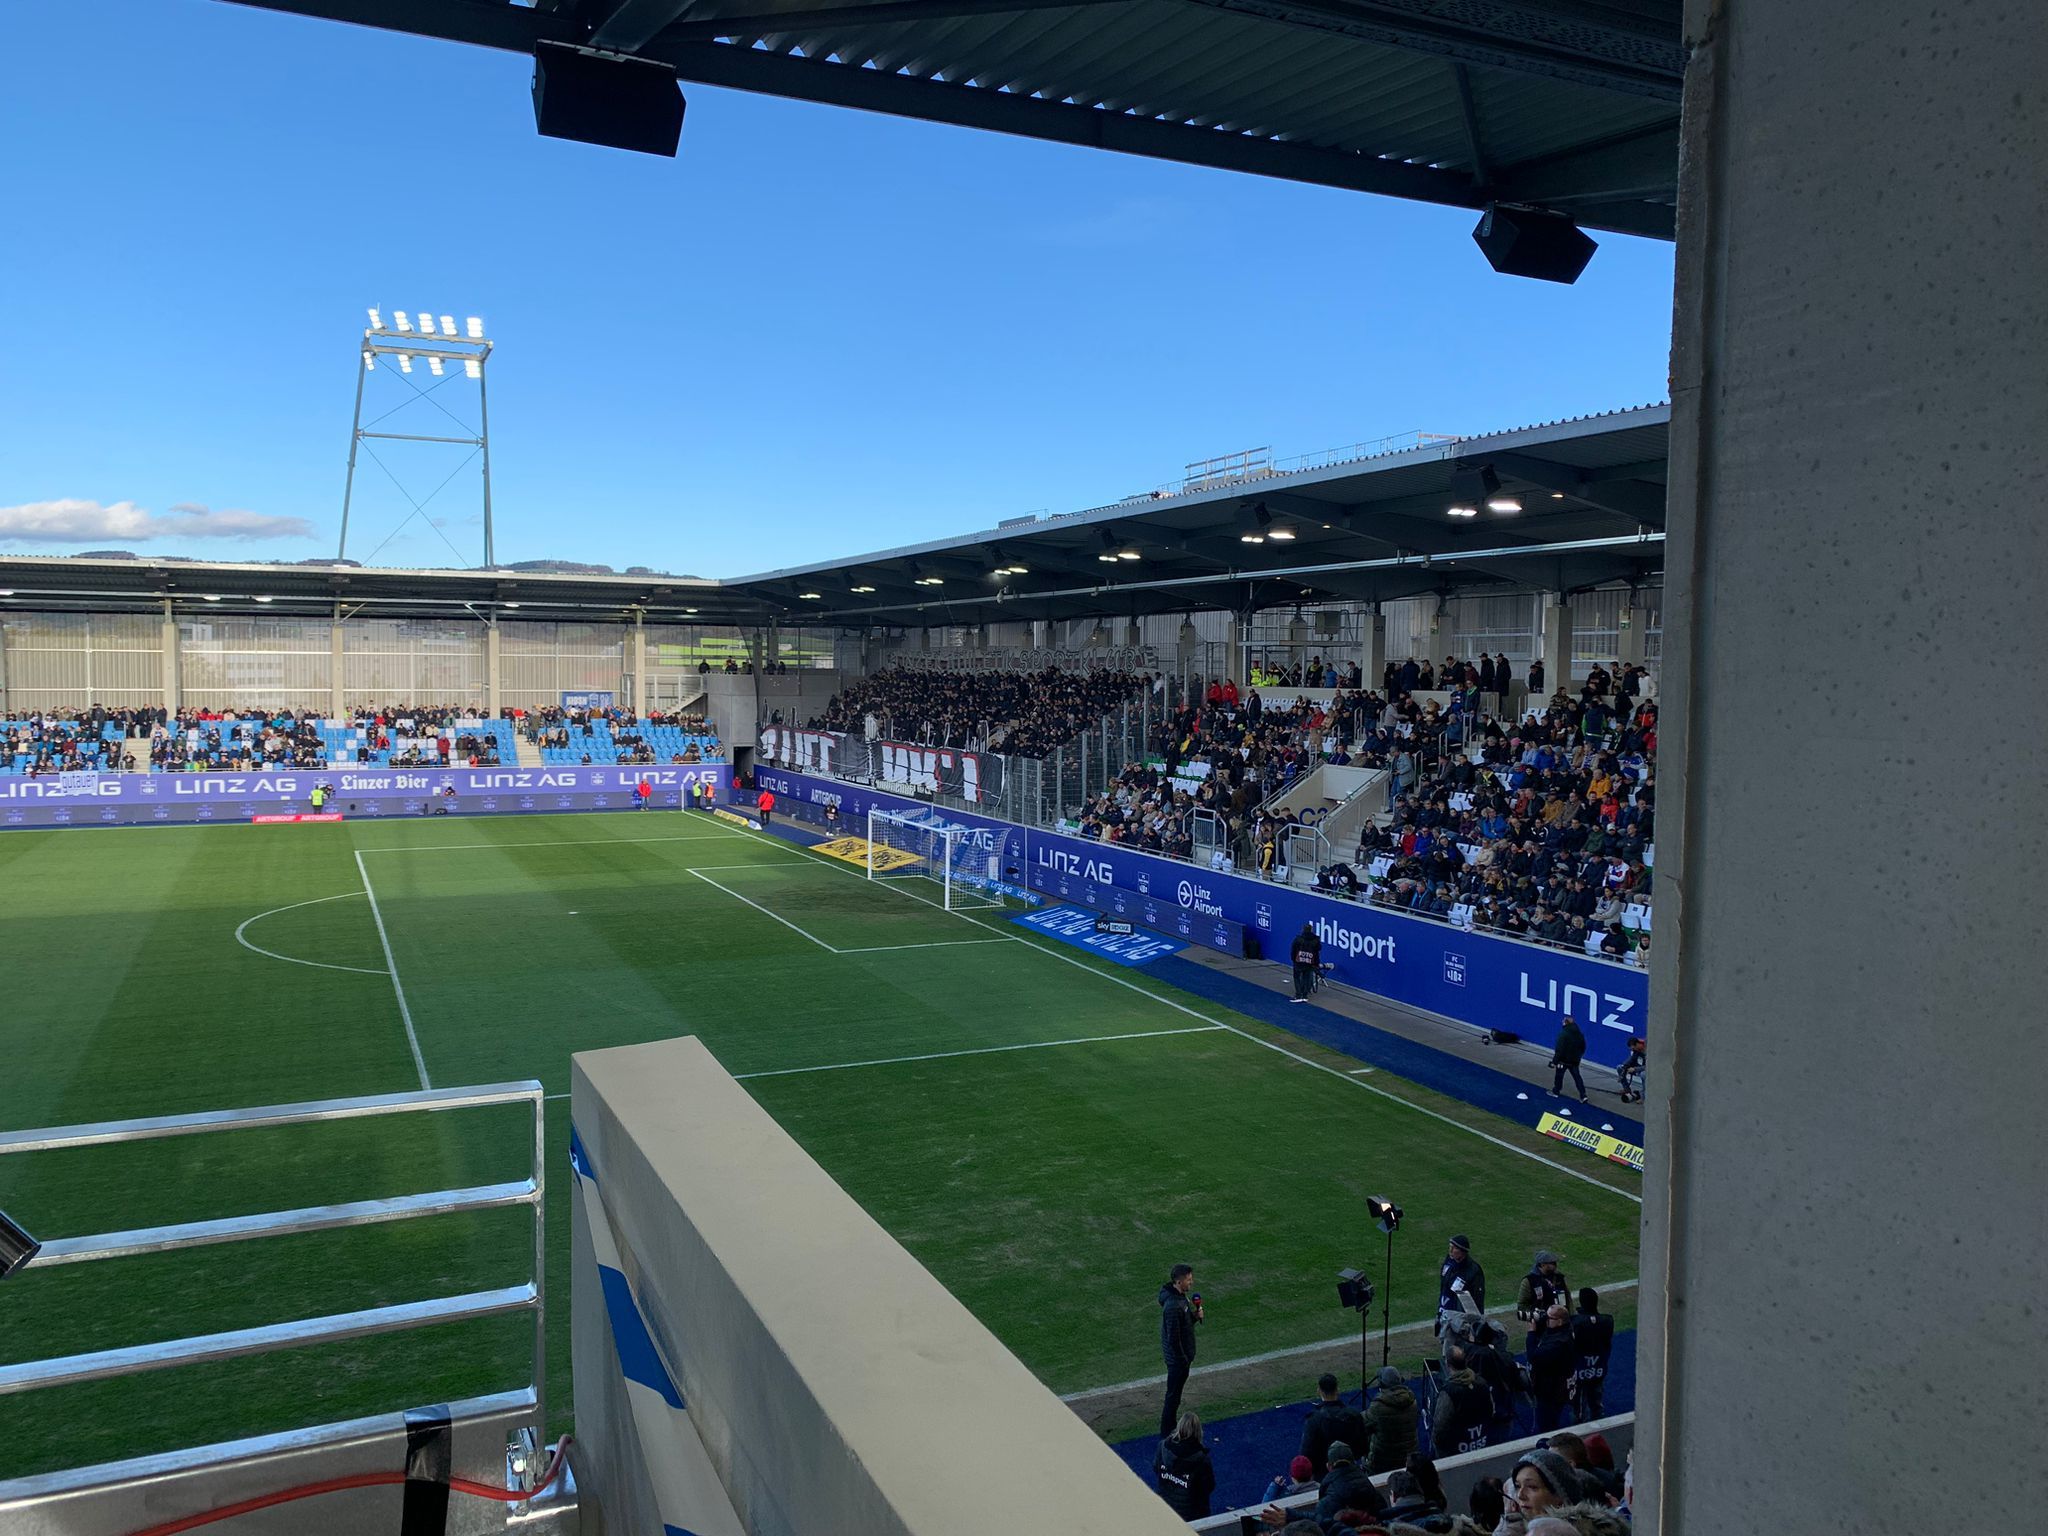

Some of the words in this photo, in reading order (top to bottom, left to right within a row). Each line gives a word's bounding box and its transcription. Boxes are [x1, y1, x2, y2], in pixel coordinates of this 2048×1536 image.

[175, 778, 247, 794] LINZ
[252, 778, 297, 793] AG
[340, 774, 392, 790] Linzer
[395, 773, 429, 789] Bier
[469, 774, 533, 788] LINZ
[537, 773, 577, 787] AG
[619, 771, 677, 785] LINZ
[683, 770, 718, 784] AG
[760, 776, 777, 792] LINZ
[777, 780, 789, 794] AG
[811, 788, 842, 809] ARTGROUP
[972, 828, 994, 851] AG
[1038, 846, 1080, 876] LINZ
[1083, 858, 1113, 885] AG
[1194, 884, 1211, 899] Linz
[1194, 898, 1223, 918] Airport
[1097, 921, 1110, 931] sky
[1309, 916, 1397, 964] uhlsport
[1520, 972, 1636, 1034] LINZ
[1614, 1143, 1644, 1164] BLÅKL
[1584, 1355, 1600, 1367] TV
[1467, 1424, 1483, 1439] TV
[1161, 1472, 1189, 1489] uhlsport
